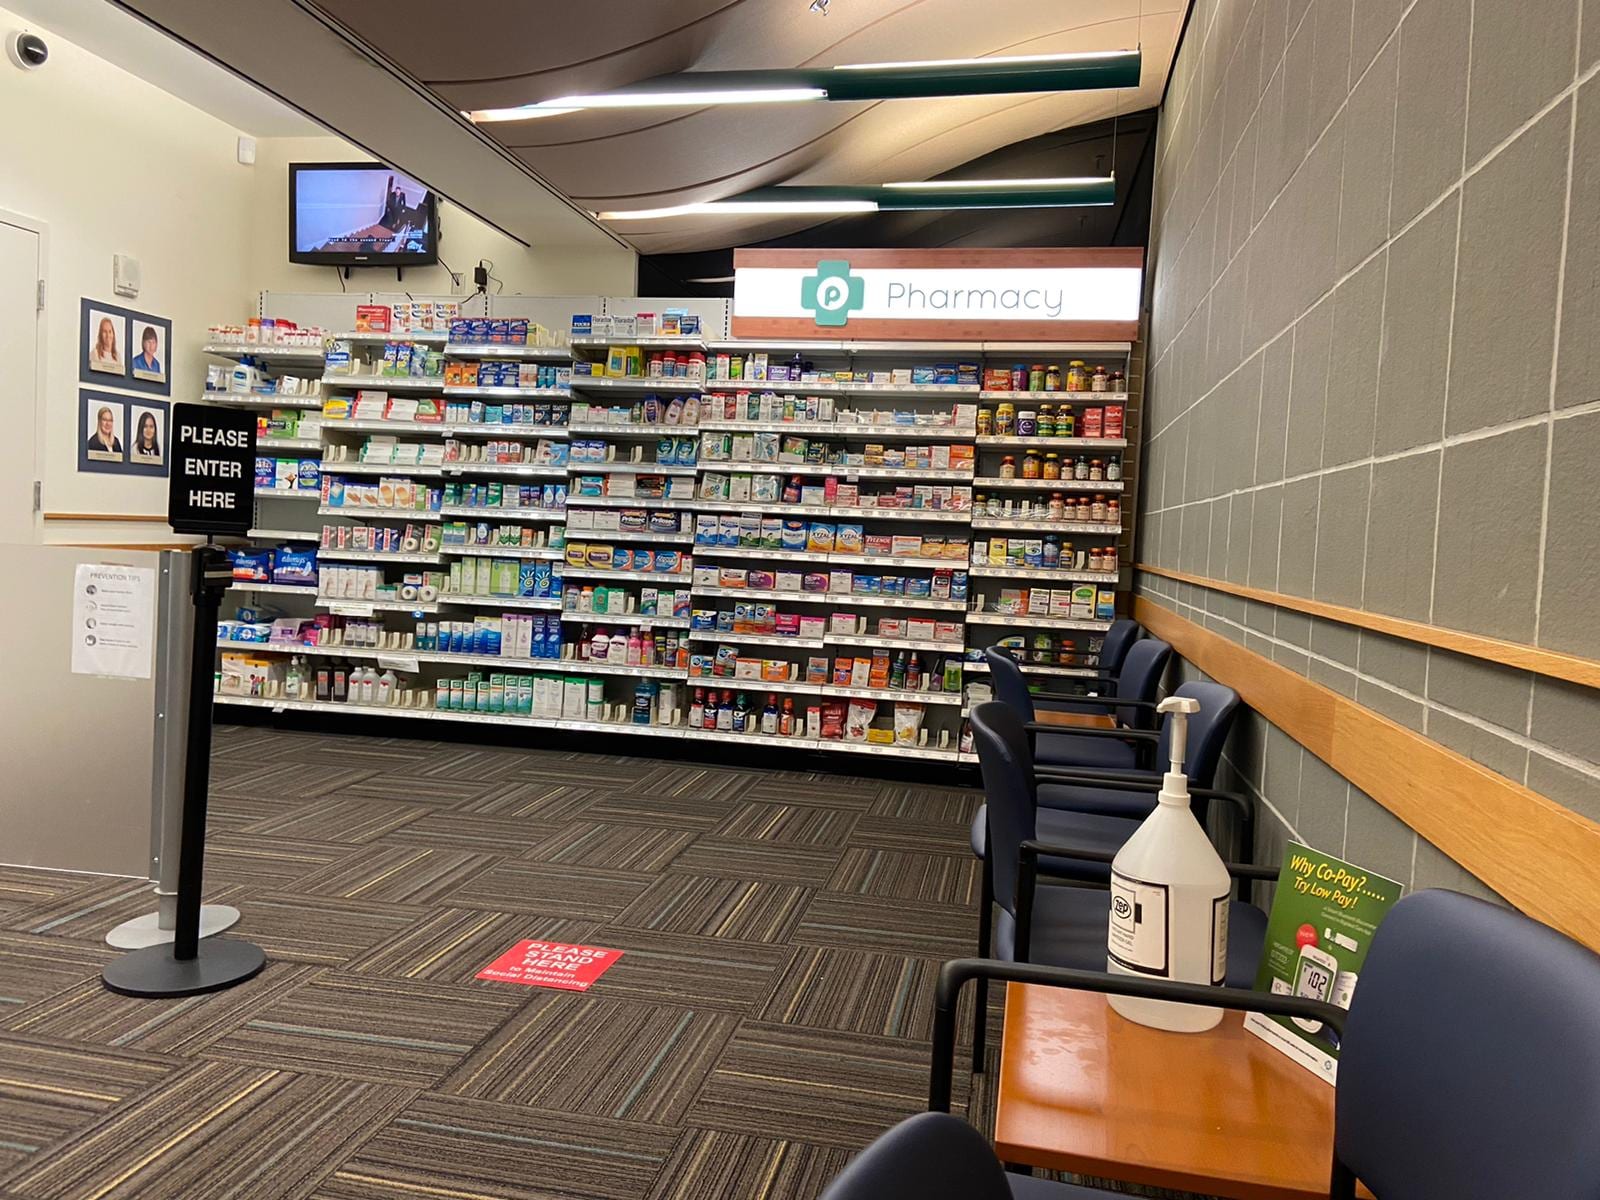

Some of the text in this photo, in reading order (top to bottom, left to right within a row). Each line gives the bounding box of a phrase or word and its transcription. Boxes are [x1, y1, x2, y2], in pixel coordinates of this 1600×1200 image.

[887, 282, 1064, 318] Pharmacy
[180, 425, 249, 448] PLEASE
[184, 458, 242, 478] ENTER
[189, 490, 236, 509] HERE
[90, 573, 141, 583] PREVENTION TIPS
[1290, 855, 1316, 878] Why
[1294, 876, 1359, 909] Try Low Pay!
[525, 951, 593, 964] STAND
[527, 943, 609, 958] PLEASE
[522, 958, 581, 971] HERE
[525, 967, 576, 979] Maintain
[484, 969, 589, 987] Social Distancing
[1307, 971, 1327, 992] 102
